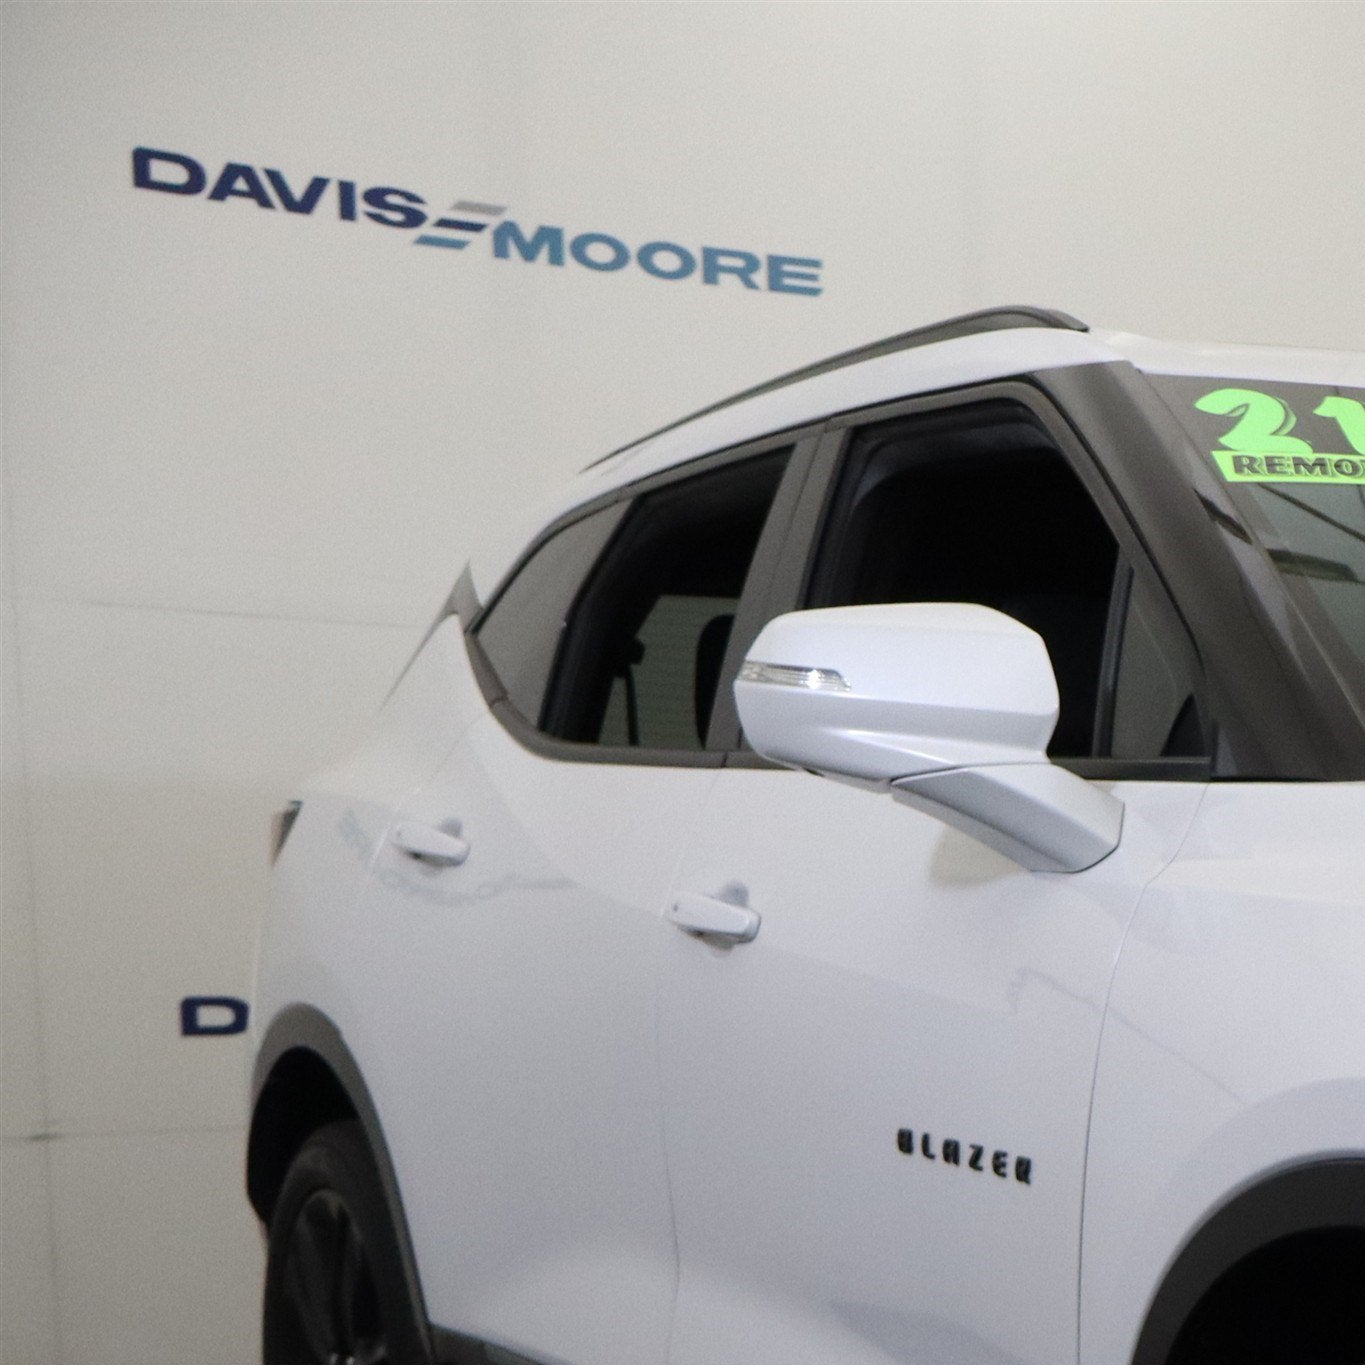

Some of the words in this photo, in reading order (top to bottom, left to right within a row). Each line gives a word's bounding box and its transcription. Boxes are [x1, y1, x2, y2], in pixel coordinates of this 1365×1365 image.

[131, 147, 428, 229] DAVIS
[493, 221, 824, 297] MOORE
[897, 1128, 1032, 1185] BLAZER
